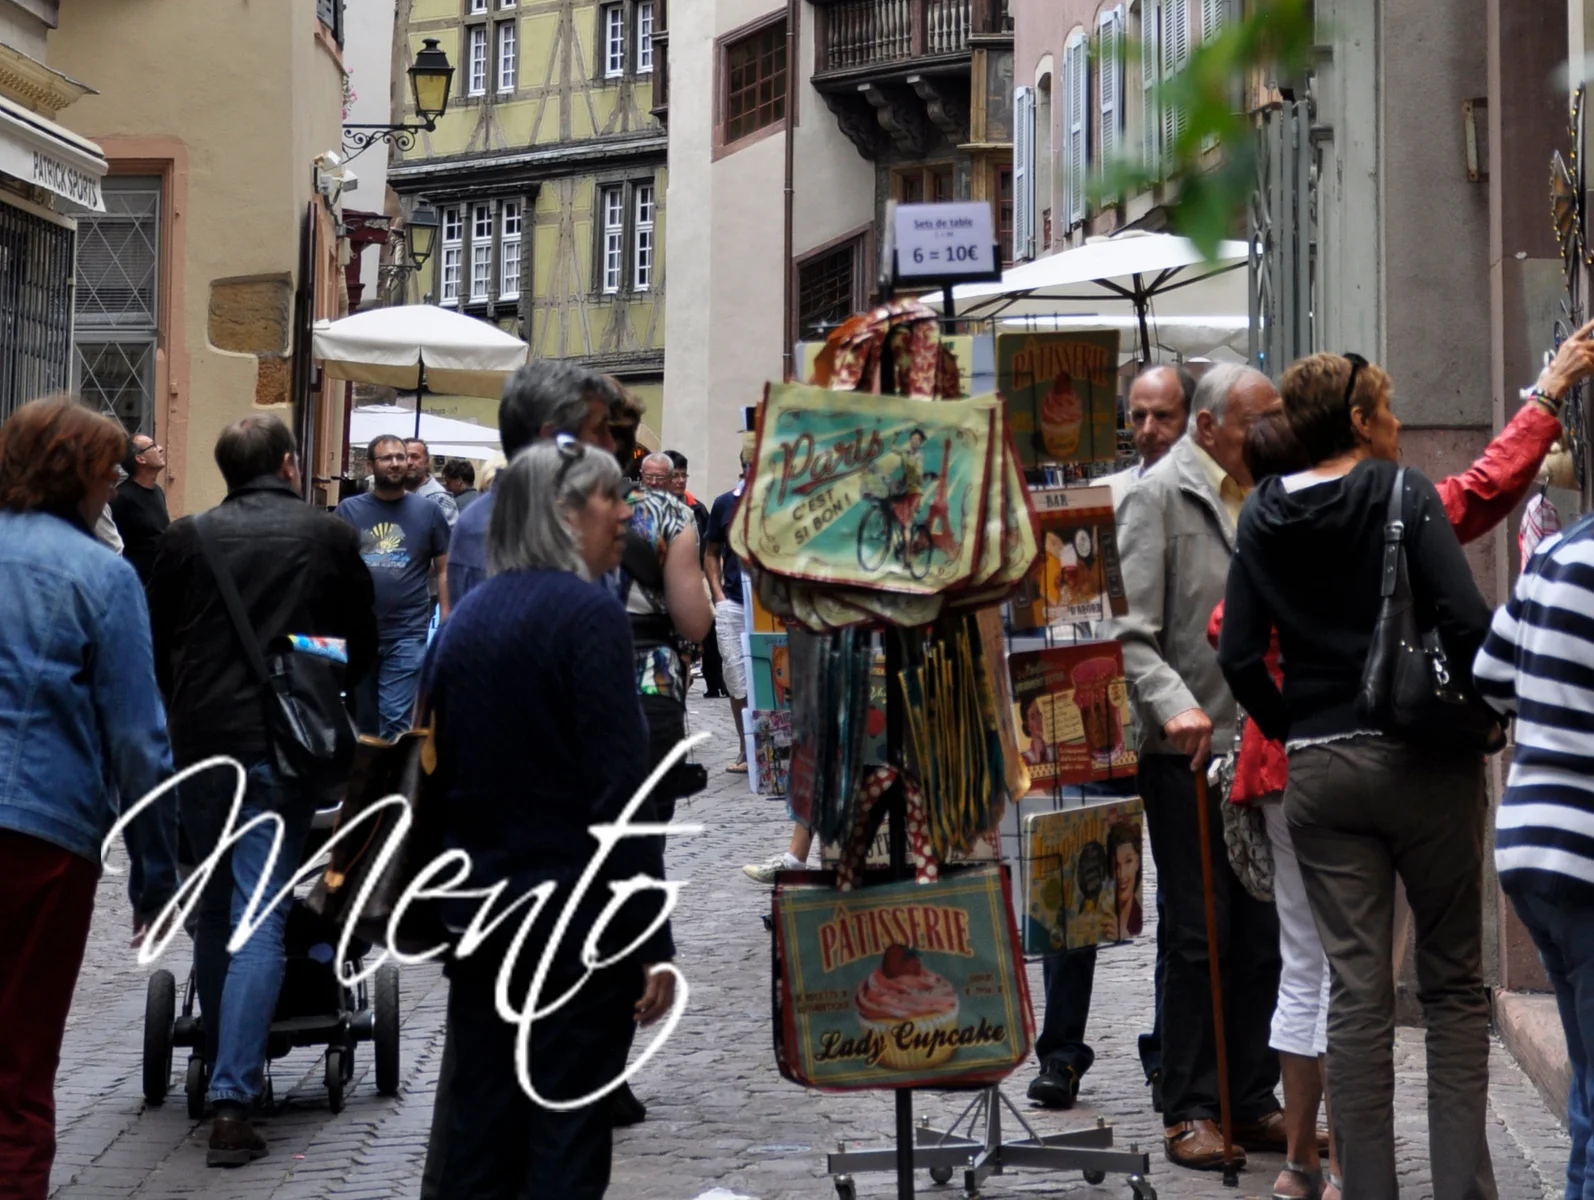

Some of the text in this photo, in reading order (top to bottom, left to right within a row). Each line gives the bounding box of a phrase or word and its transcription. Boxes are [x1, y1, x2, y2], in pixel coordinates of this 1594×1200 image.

[33, 150, 98, 208] PATRICK SPORTS
[913, 216, 973, 230] Sets de table
[913, 247, 924, 264] 6
[946, 245, 979, 263] 10€
[777, 428, 884, 506] Paris
[792, 488, 833, 521] C'EST
[1045, 494, 1069, 508] BAR
[794, 526, 809, 545] SI
[818, 901, 974, 973] PÂTISSERIE
[814, 1017, 1005, 1067] Lady Cupcake
